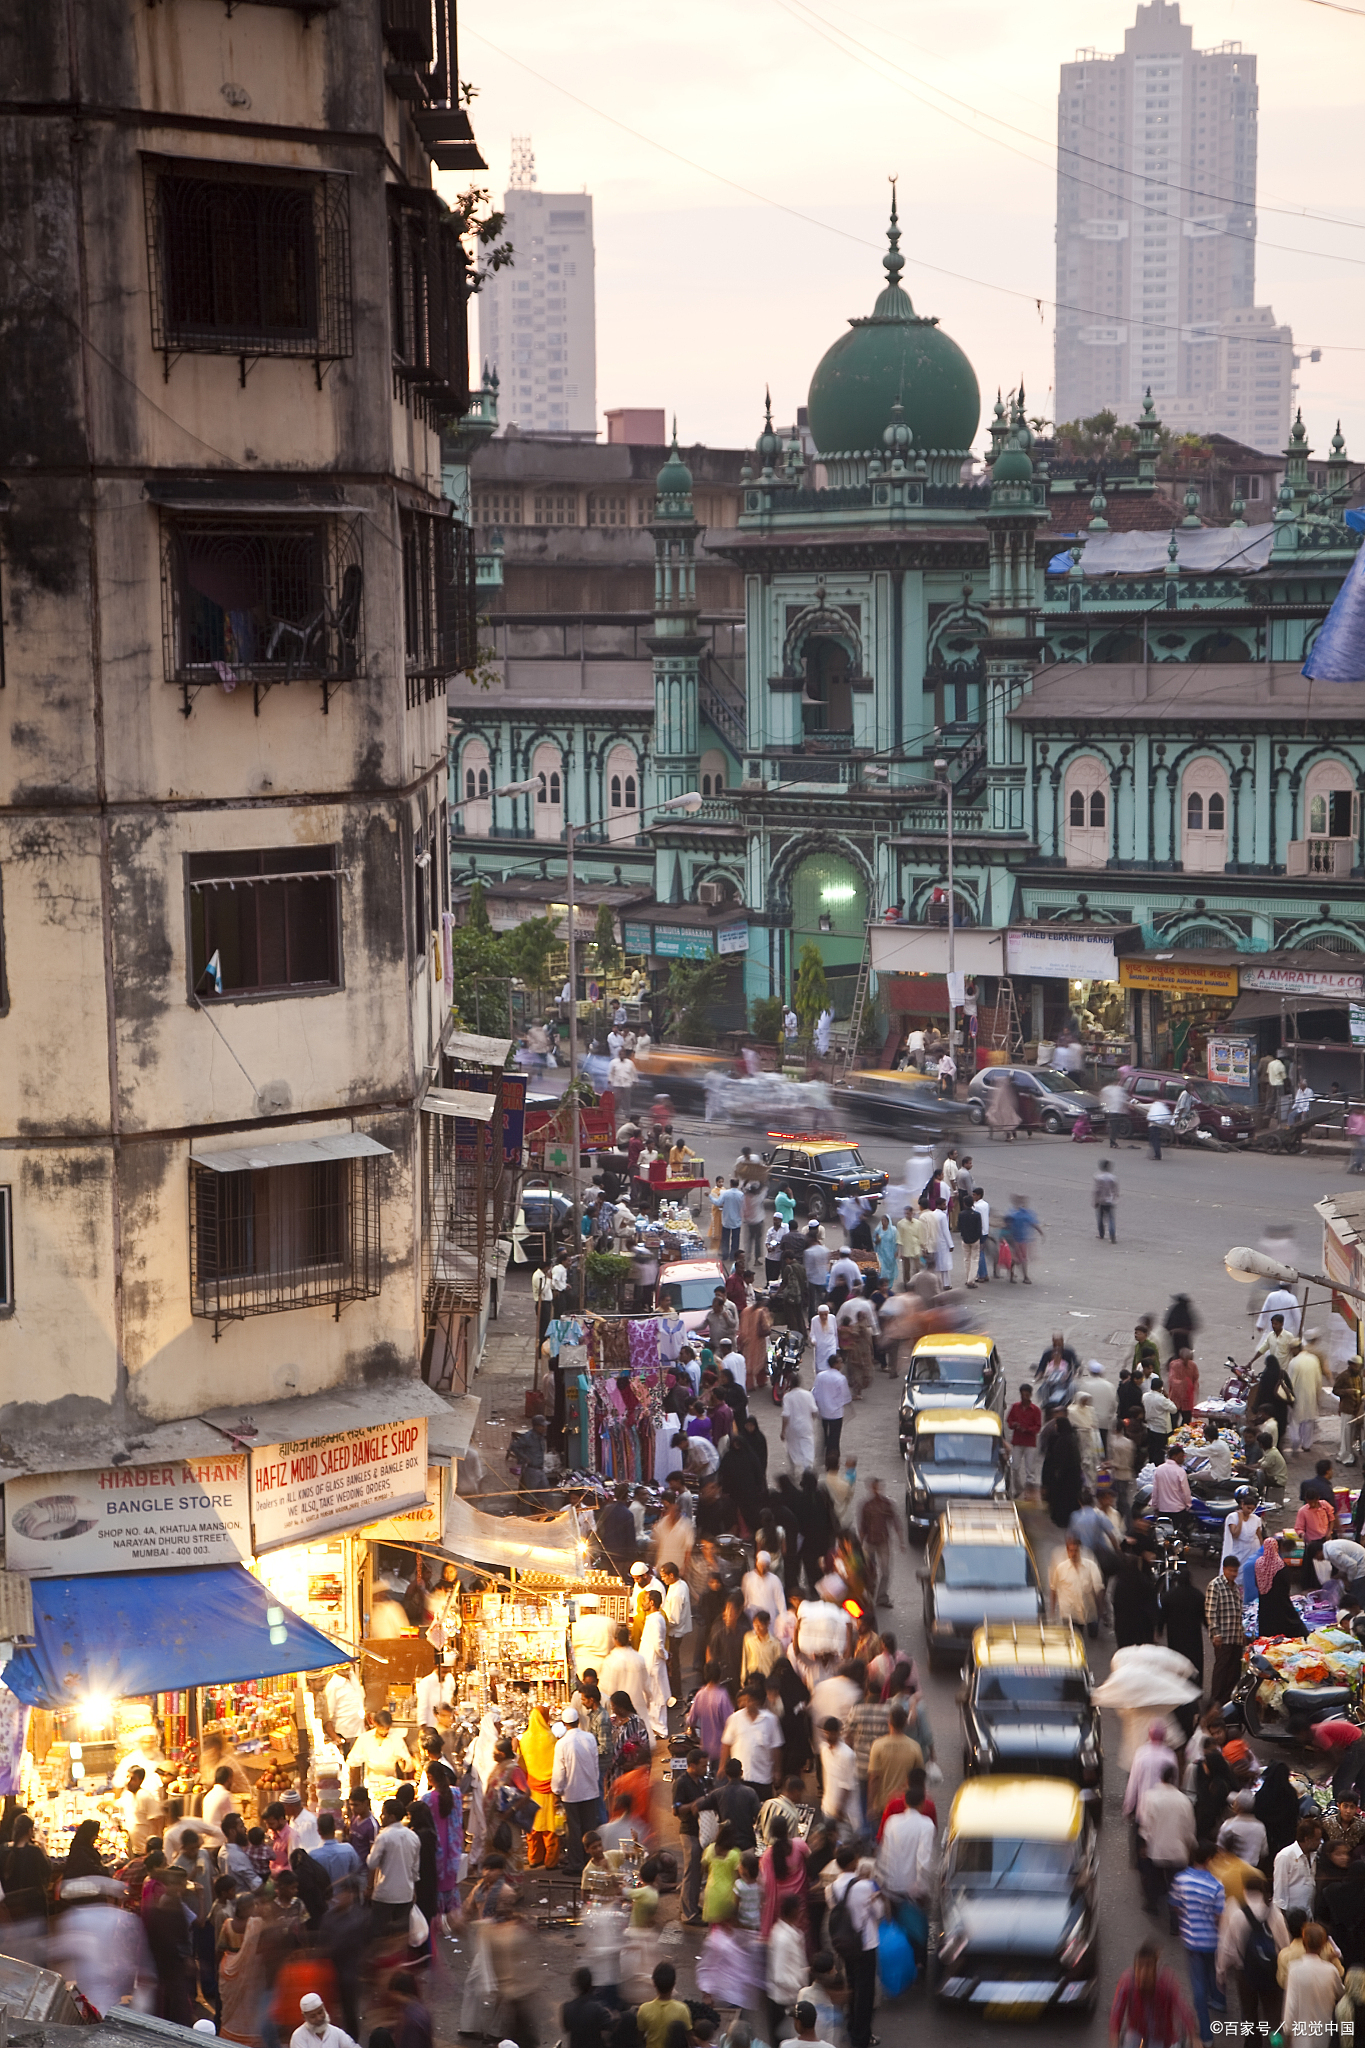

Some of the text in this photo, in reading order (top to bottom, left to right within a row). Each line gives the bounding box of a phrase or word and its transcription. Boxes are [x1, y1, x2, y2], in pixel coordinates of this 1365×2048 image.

[255, 1462, 288, 1493] HAFIZ
[321, 1445, 350, 1476] SAEED
[353, 1435, 388, 1468] BANGLE
[391, 1427, 418, 1457] SHOP
[182, 1464, 238, 1485] KHAN
[298, 1486, 314, 1499] KINDS
[315, 1483, 324, 1495] OF
[325, 1478, 344, 1493] GLASS
[346, 1470, 371, 1486] BANGLES
[380, 1460, 403, 1476] BANGLE
[405, 1457, 418, 1469] BOX
[106, 1494, 233, 1515] BANGLE STORE
[288, 1505, 298, 1517] WE
[319, 1495, 334, 1508] TAKE
[336, 1487, 364, 1503] WEDDING
[366, 1479, 391, 1495] ORDERS
[98, 1529, 123, 1539] SHOP
[125, 1527, 141, 1537] NO.
[159, 1523, 197, 1534] KHATIJA
[113, 1536, 156, 1548] NARAYAN
[158, 1534, 190, 1545] DHURU
[132, 1548, 169, 1558] MUMBAI
[176, 1546, 191, 1556] 400
